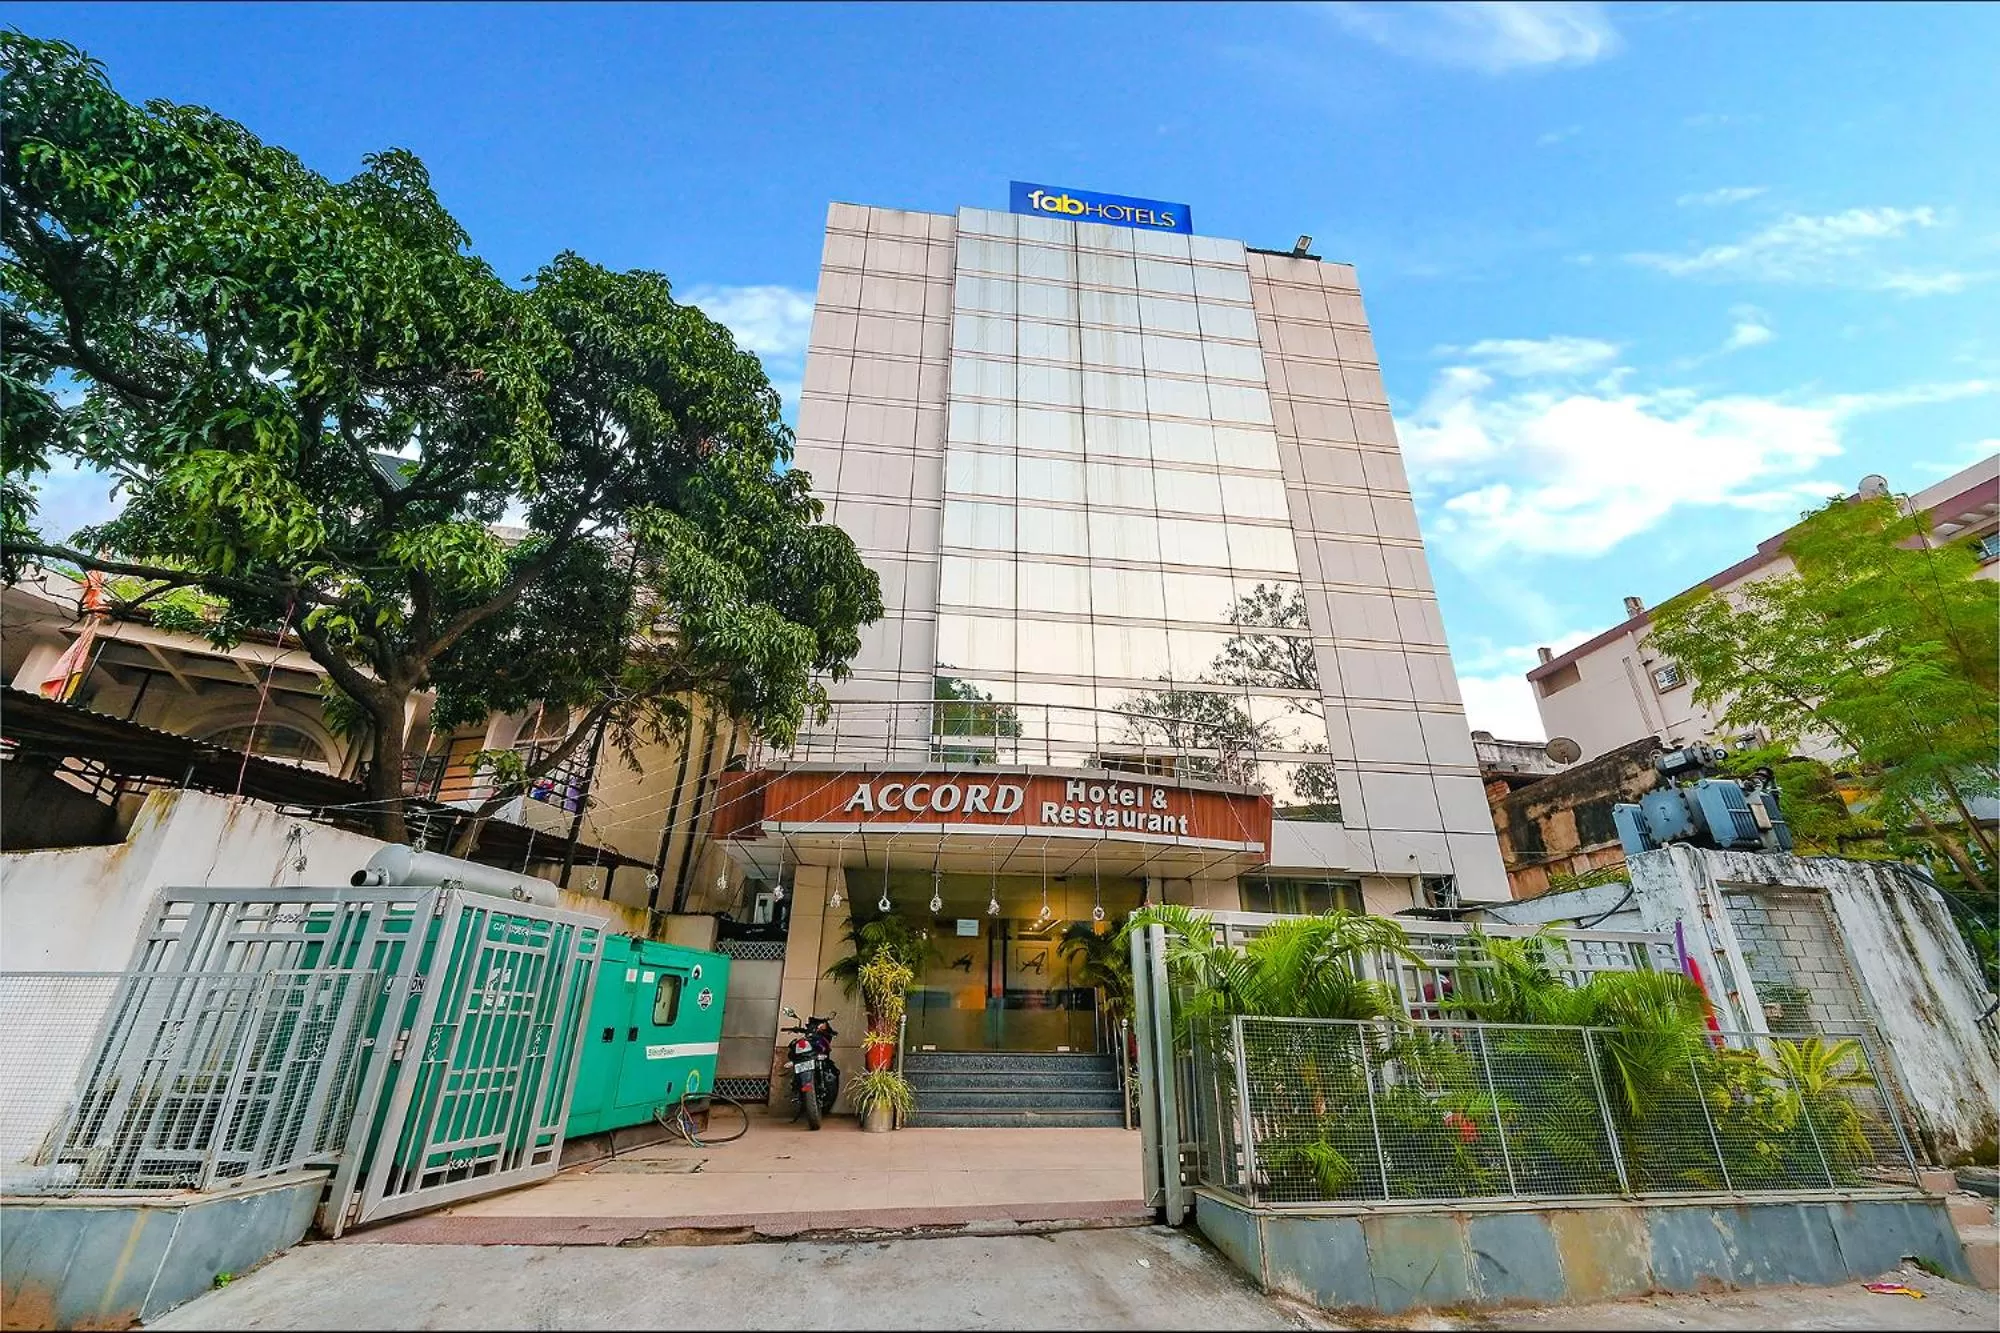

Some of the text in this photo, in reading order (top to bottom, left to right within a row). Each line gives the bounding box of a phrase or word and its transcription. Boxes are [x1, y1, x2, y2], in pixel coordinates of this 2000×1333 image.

[844, 783, 1024, 813] ACCORD
[1066, 780, 1168, 809] Hotel &
[1041, 801, 1188, 834] Restaurant
